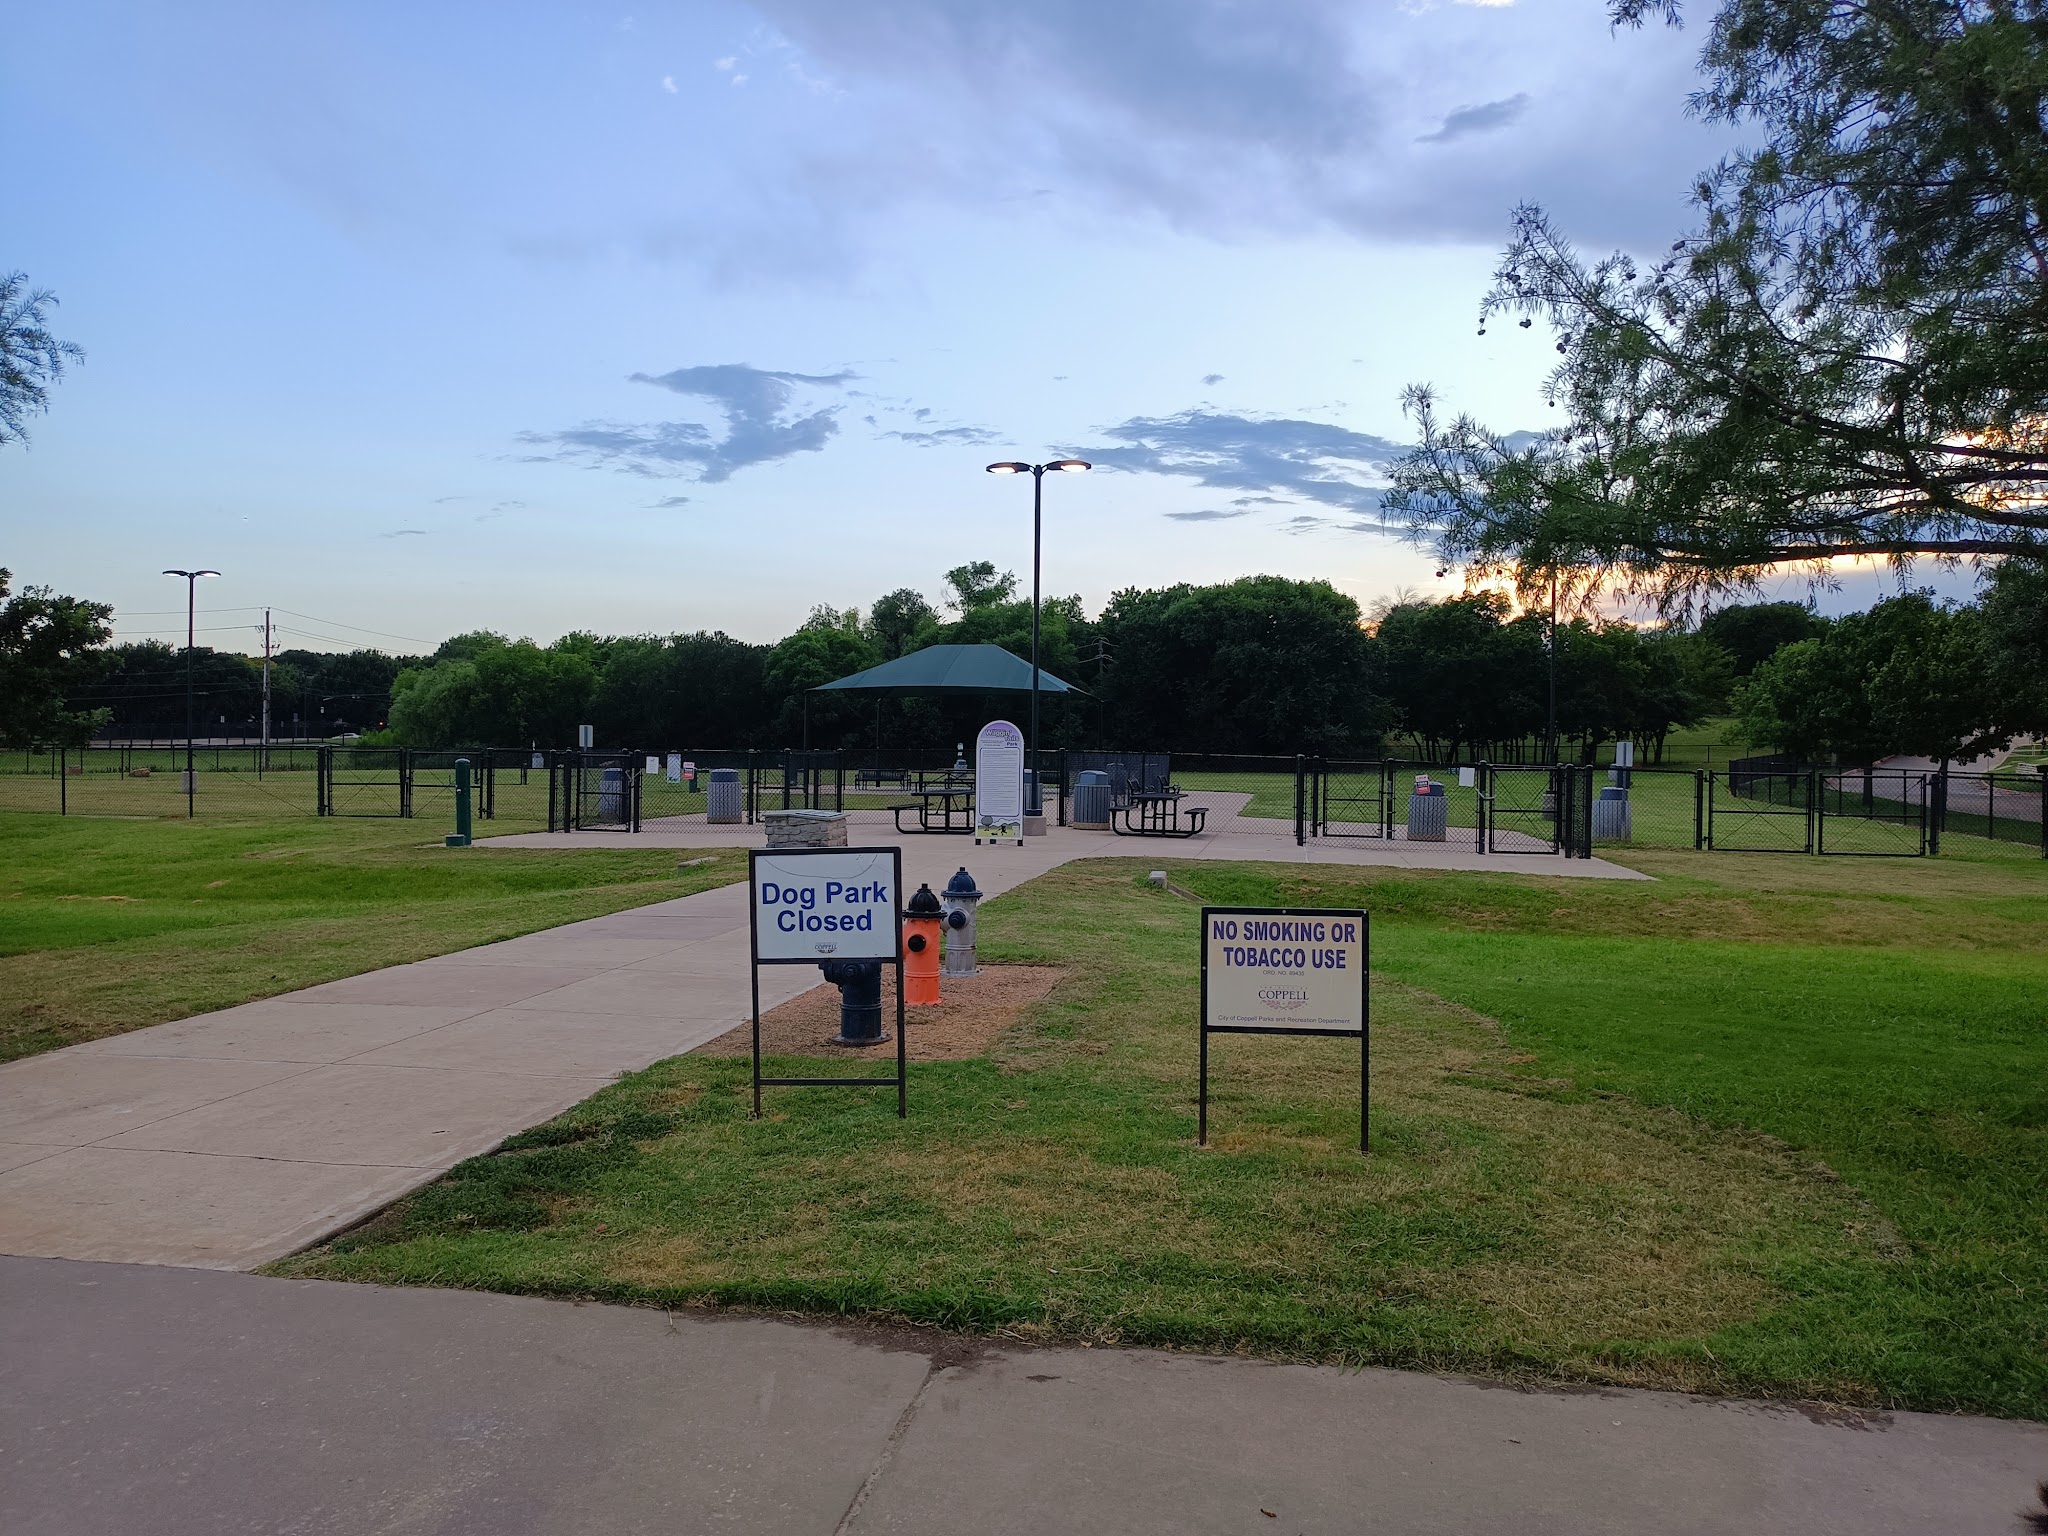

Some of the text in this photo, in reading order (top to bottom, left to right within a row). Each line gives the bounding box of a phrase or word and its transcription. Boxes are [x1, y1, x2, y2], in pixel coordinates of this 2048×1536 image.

[762, 881, 888, 910] Dog Park
[777, 909, 872, 932] Closed
[1213, 920, 1356, 943] NO SMOKING OR
[1223, 947, 1346, 969] TOBACCO USE
[1258, 989, 1310, 1001] COPPELL
[1217, 1014, 1229, 1022] City
[1236, 1015, 1258, 1023] Coppell
[1287, 1016, 1317, 1024] Recreation
[1317, 1017, 1351, 1025] Department
